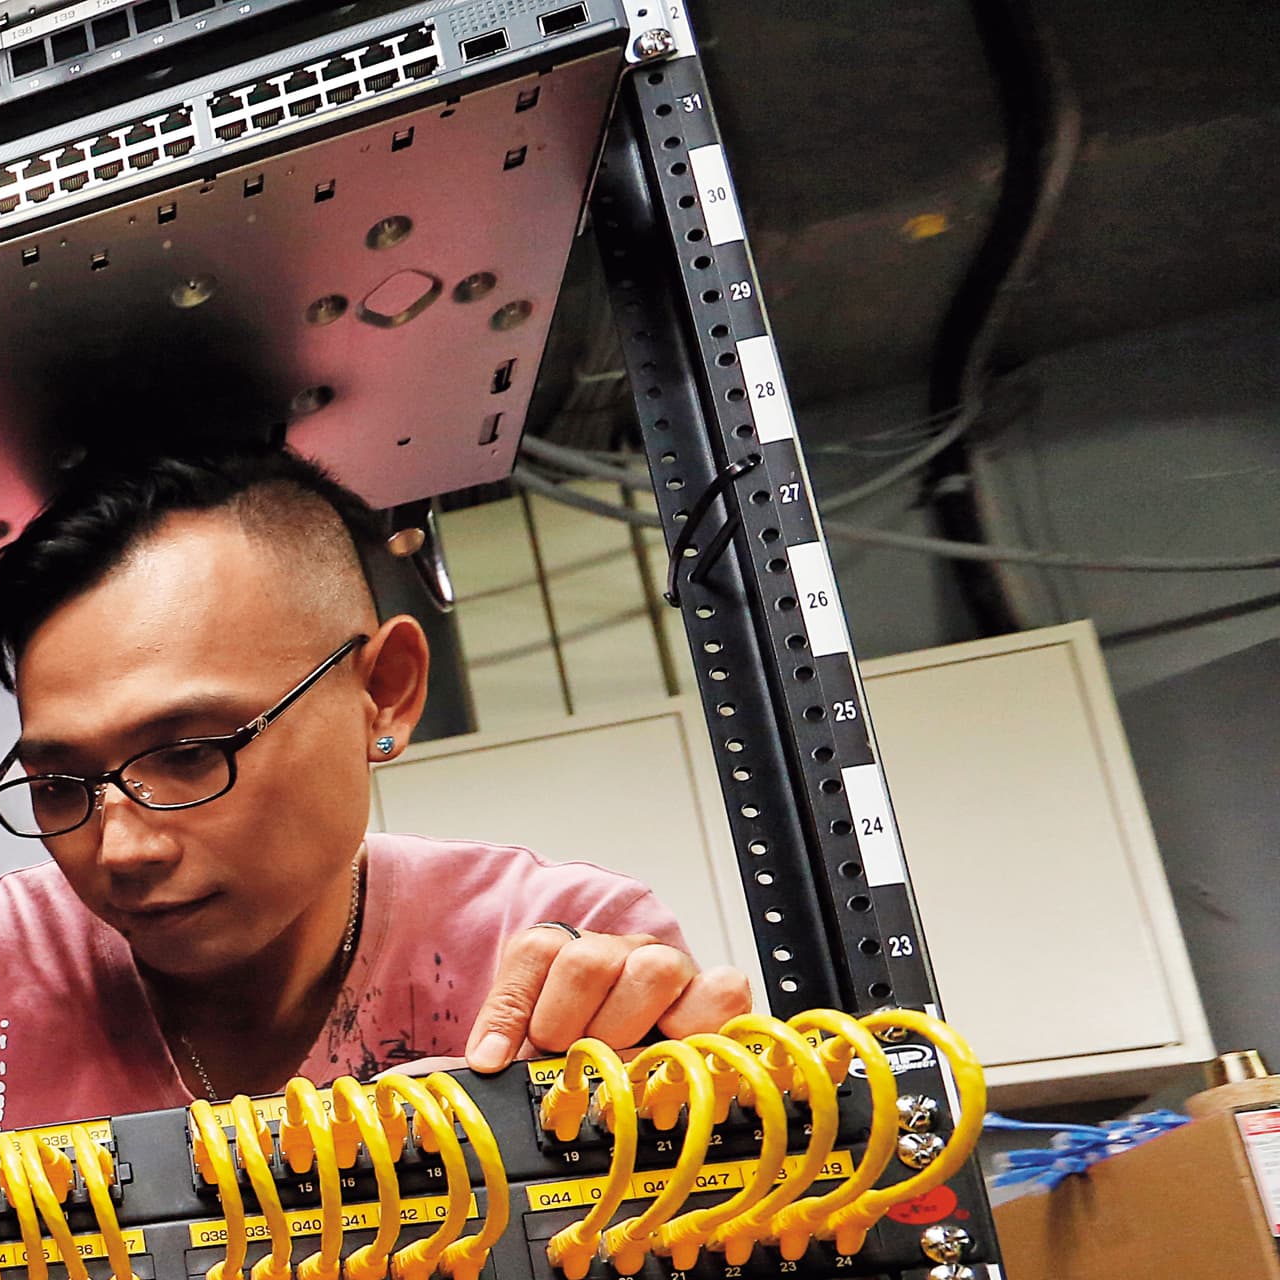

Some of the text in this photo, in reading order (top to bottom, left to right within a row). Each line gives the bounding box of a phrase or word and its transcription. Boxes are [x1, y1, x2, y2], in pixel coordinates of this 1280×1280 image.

[683, 93, 703, 112] 31
[707, 186, 727, 204] 30
[730, 281, 752, 300] 29
[755, 381, 776, 399] 28
[779, 483, 800, 503] 27
[807, 591, 829, 608] 26
[832, 701, 857, 721] 25
[861, 818, 884, 836] 24
[888, 936, 913, 957] 23
[657, 1141, 673, 1151] 21
[539, 1174, 729, 1205] Q44 Q47
[292, 1219, 322, 1233] Q40
[725, 1267, 741, 1277] 22
[836, 1256, 853, 1266] 24
